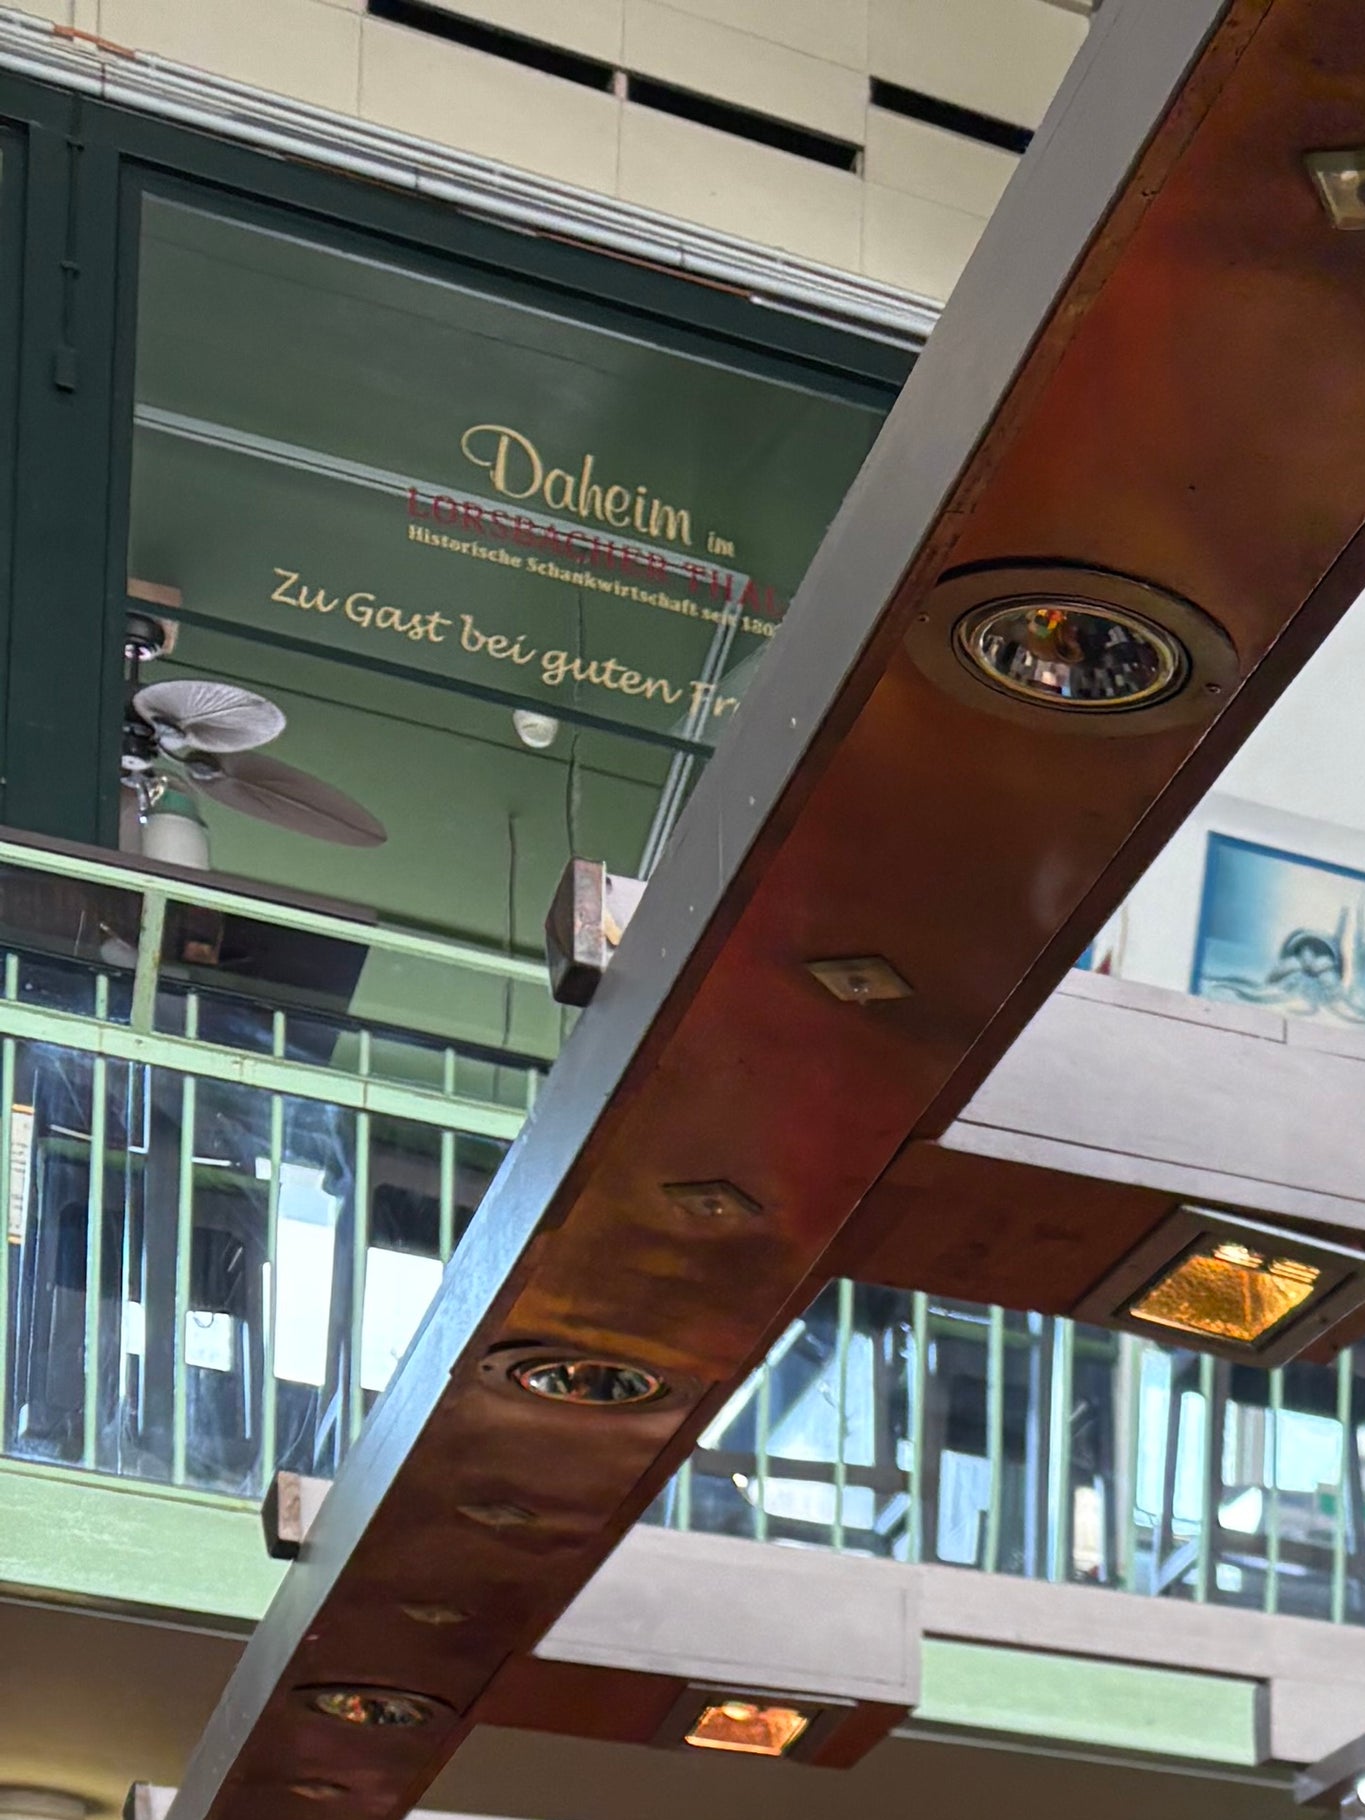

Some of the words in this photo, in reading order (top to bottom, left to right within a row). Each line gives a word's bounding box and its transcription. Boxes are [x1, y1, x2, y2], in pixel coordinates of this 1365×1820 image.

[461, 424, 692, 546] Daheim
[707, 532, 736, 557] im
[270, 567, 339, 614] Zu
[345, 591, 452, 643] Gast
[460, 613, 537, 666] bei
[540, 646, 682, 705] guten
[408, 524, 522, 568] Historische
[526, 555, 700, 616] Schankwirtschaft
[741, 614, 780, 638] 180
